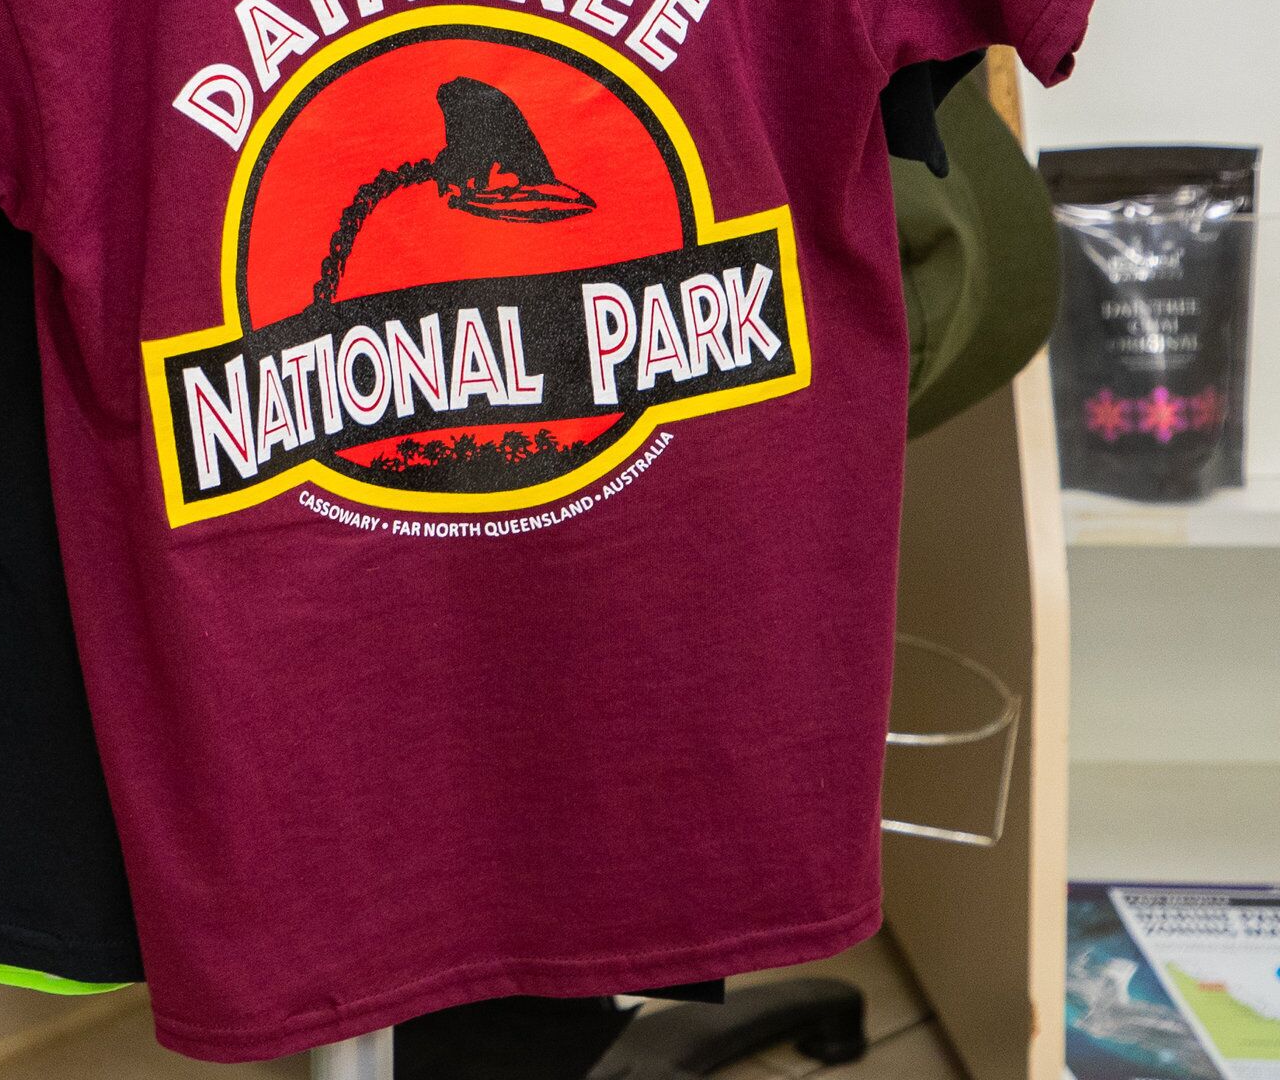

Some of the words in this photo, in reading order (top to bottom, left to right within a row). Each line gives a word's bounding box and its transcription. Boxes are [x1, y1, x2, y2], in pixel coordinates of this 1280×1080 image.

[182, 306, 544, 490] NATIONAL
[581, 263, 782, 406] PARK
[299, 490, 379, 531] CASSOWARY
[392, 520, 420, 535] FAR
[424, 523, 481, 537] NORTH
[485, 495, 594, 538] QUEENSLAND
[602, 431, 674, 499] AUSTRALIA
